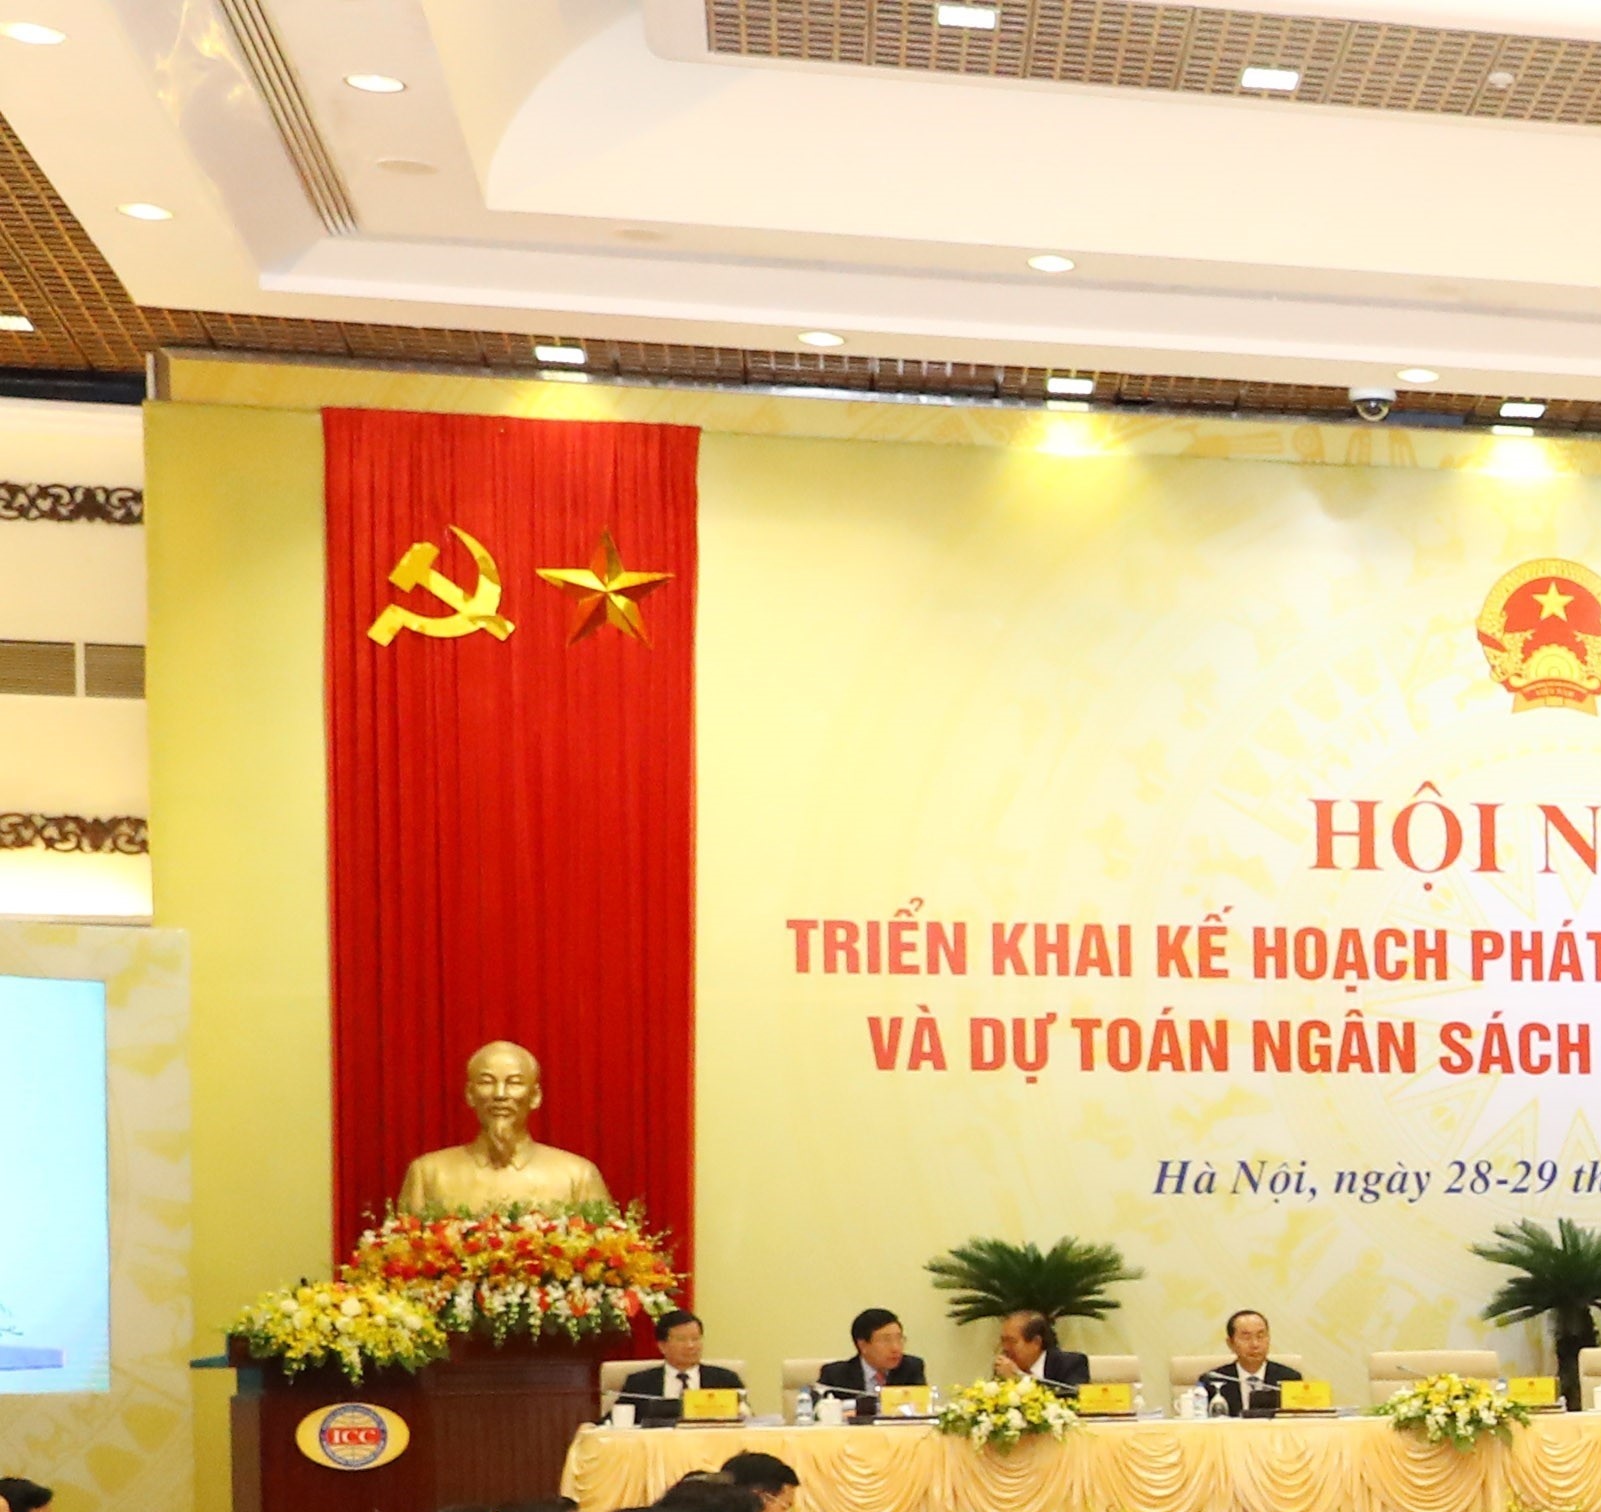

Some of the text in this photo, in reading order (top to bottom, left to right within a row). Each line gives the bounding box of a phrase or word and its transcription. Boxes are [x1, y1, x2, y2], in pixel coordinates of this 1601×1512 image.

[1311, 781, 1504, 892] HỘI
[787, 897, 967, 975] TRIỂN
[992, 922, 1132, 977] KHAI
[1157, 905, 1232, 979] KẾ
[1253, 926, 1448, 993] HOẠCH
[867, 1004, 947, 1071] VÀ
[969, 1012, 1058, 1084] DỰ
[1071, 1007, 1229, 1073] TOÁN
[1252, 1008, 1416, 1074] NGÂN
[1439, 1011, 1591, 1075] SÁCH
[1153, 1160, 1216, 1194] Hà
[1232, 1160, 1317, 1203] Nội,
[1334, 1162, 1431, 1203] ngày
[1445, 1160, 1558, 1194] 28-29
[332, 1428, 377, 1444] ICC
